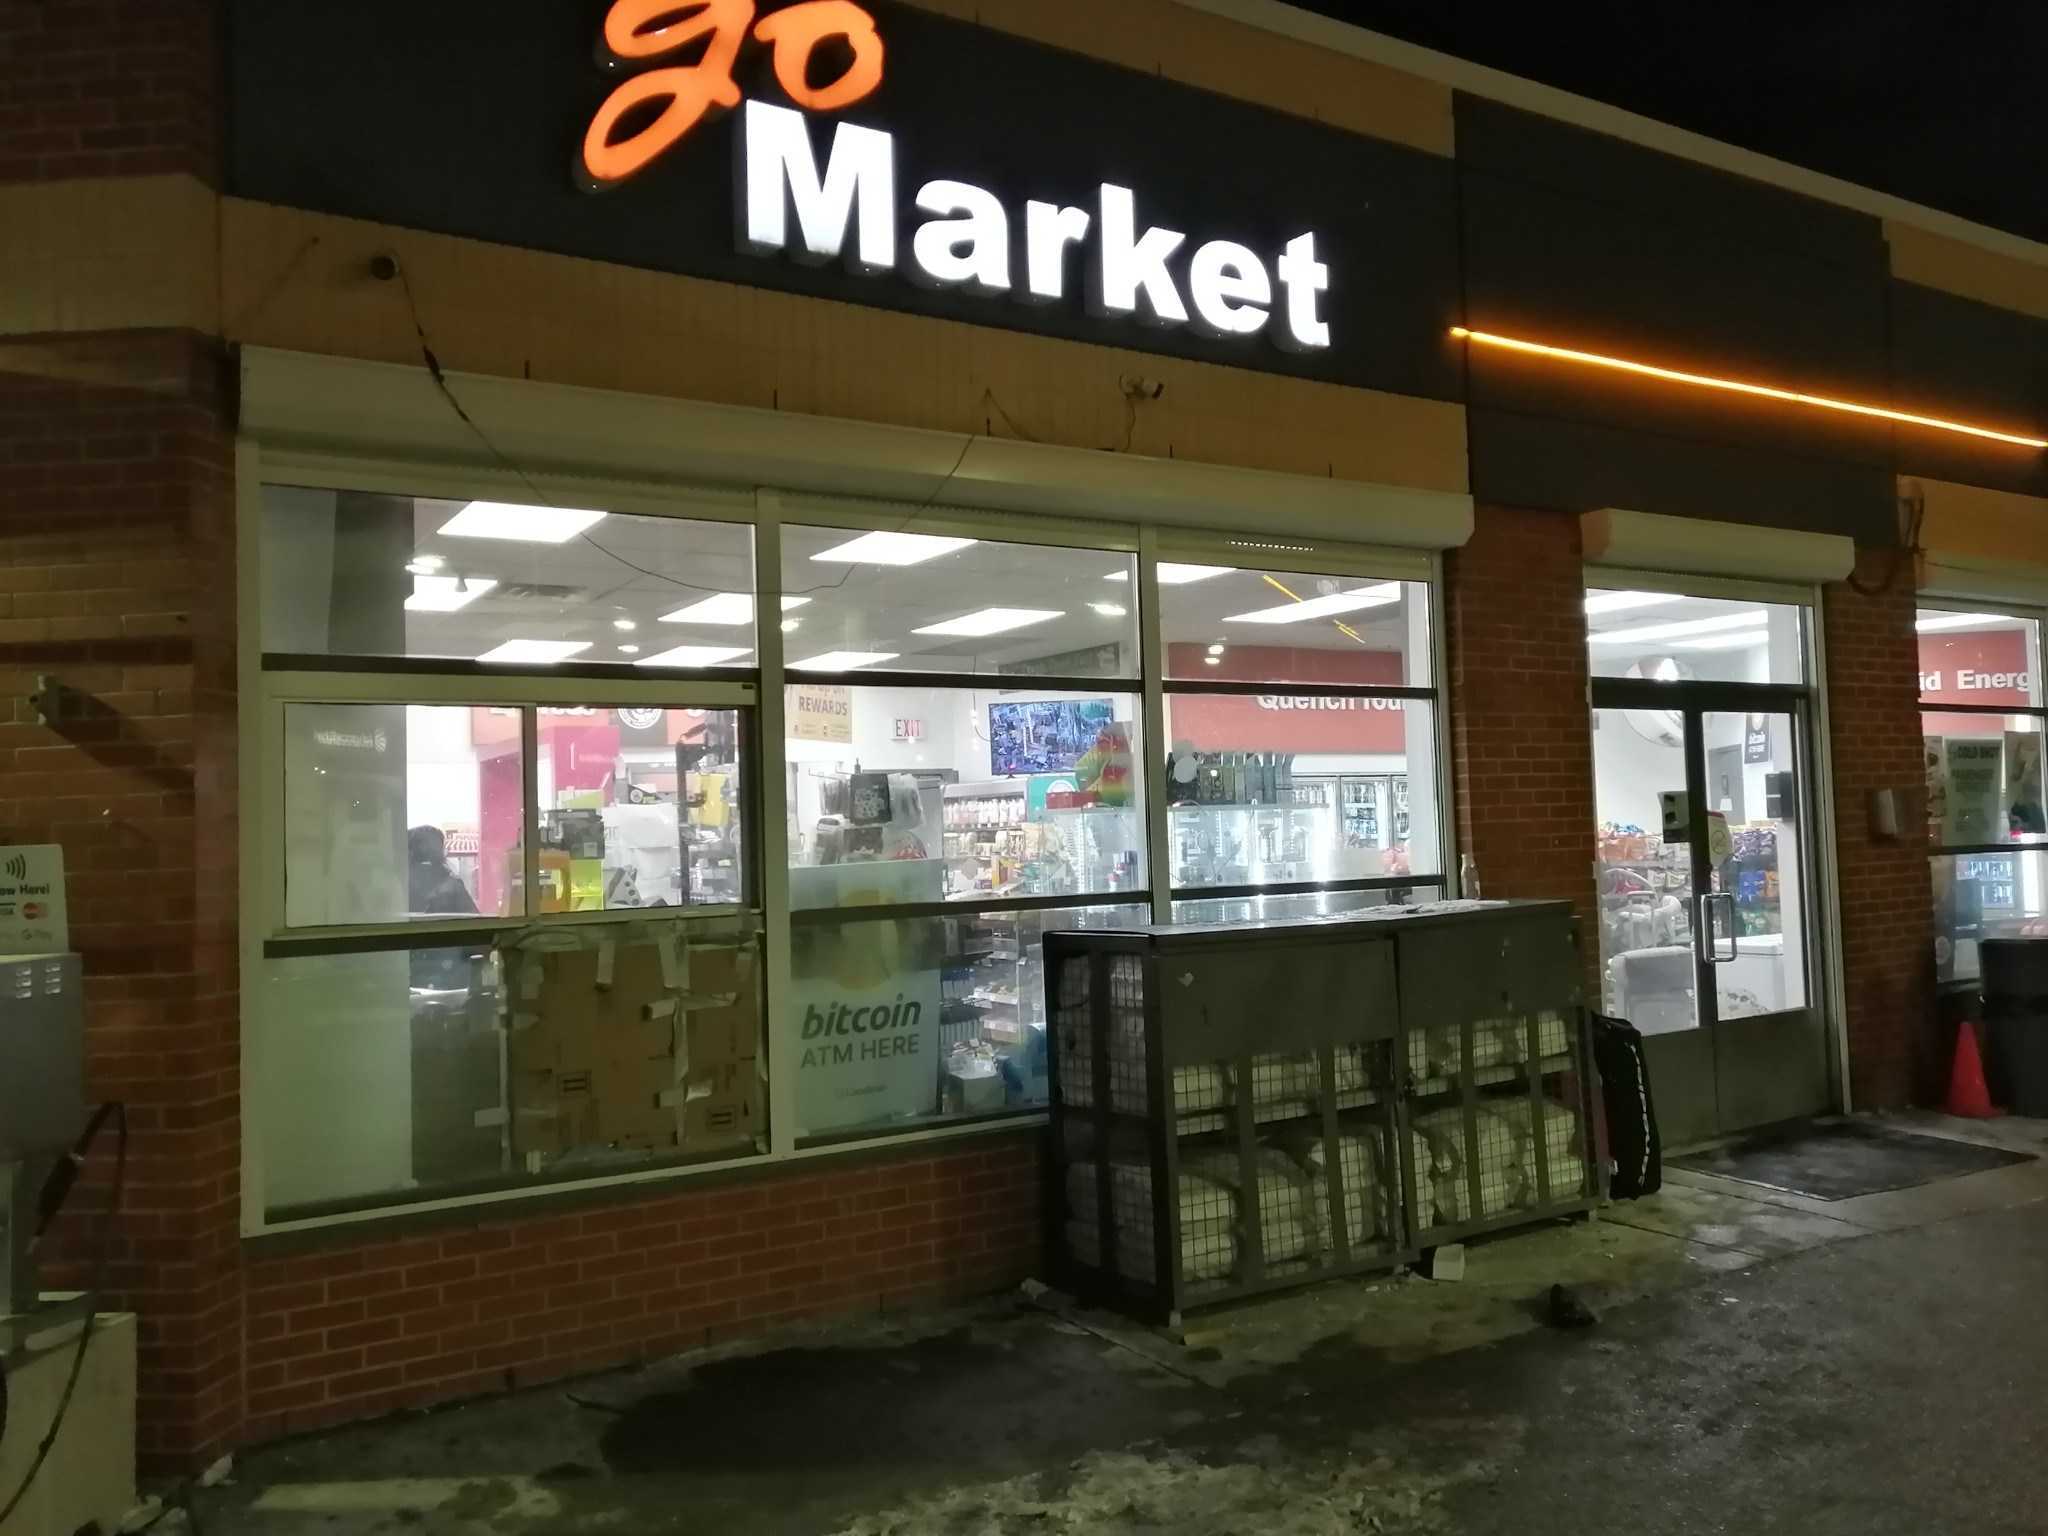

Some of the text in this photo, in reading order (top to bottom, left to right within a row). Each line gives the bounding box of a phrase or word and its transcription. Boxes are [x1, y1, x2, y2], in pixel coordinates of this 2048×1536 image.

[584, 0, 884, 179] go
[746, 99, 1330, 348] Market
[1919, 669, 2029, 692] id Energ
[799, 696, 848, 716] REWARDS
[895, 719, 921, 737] EXIT
[0, 887, 16, 896] ow
[801, 992, 921, 1039] bitcoin
[800, 1033, 920, 1069] ATM HERE
